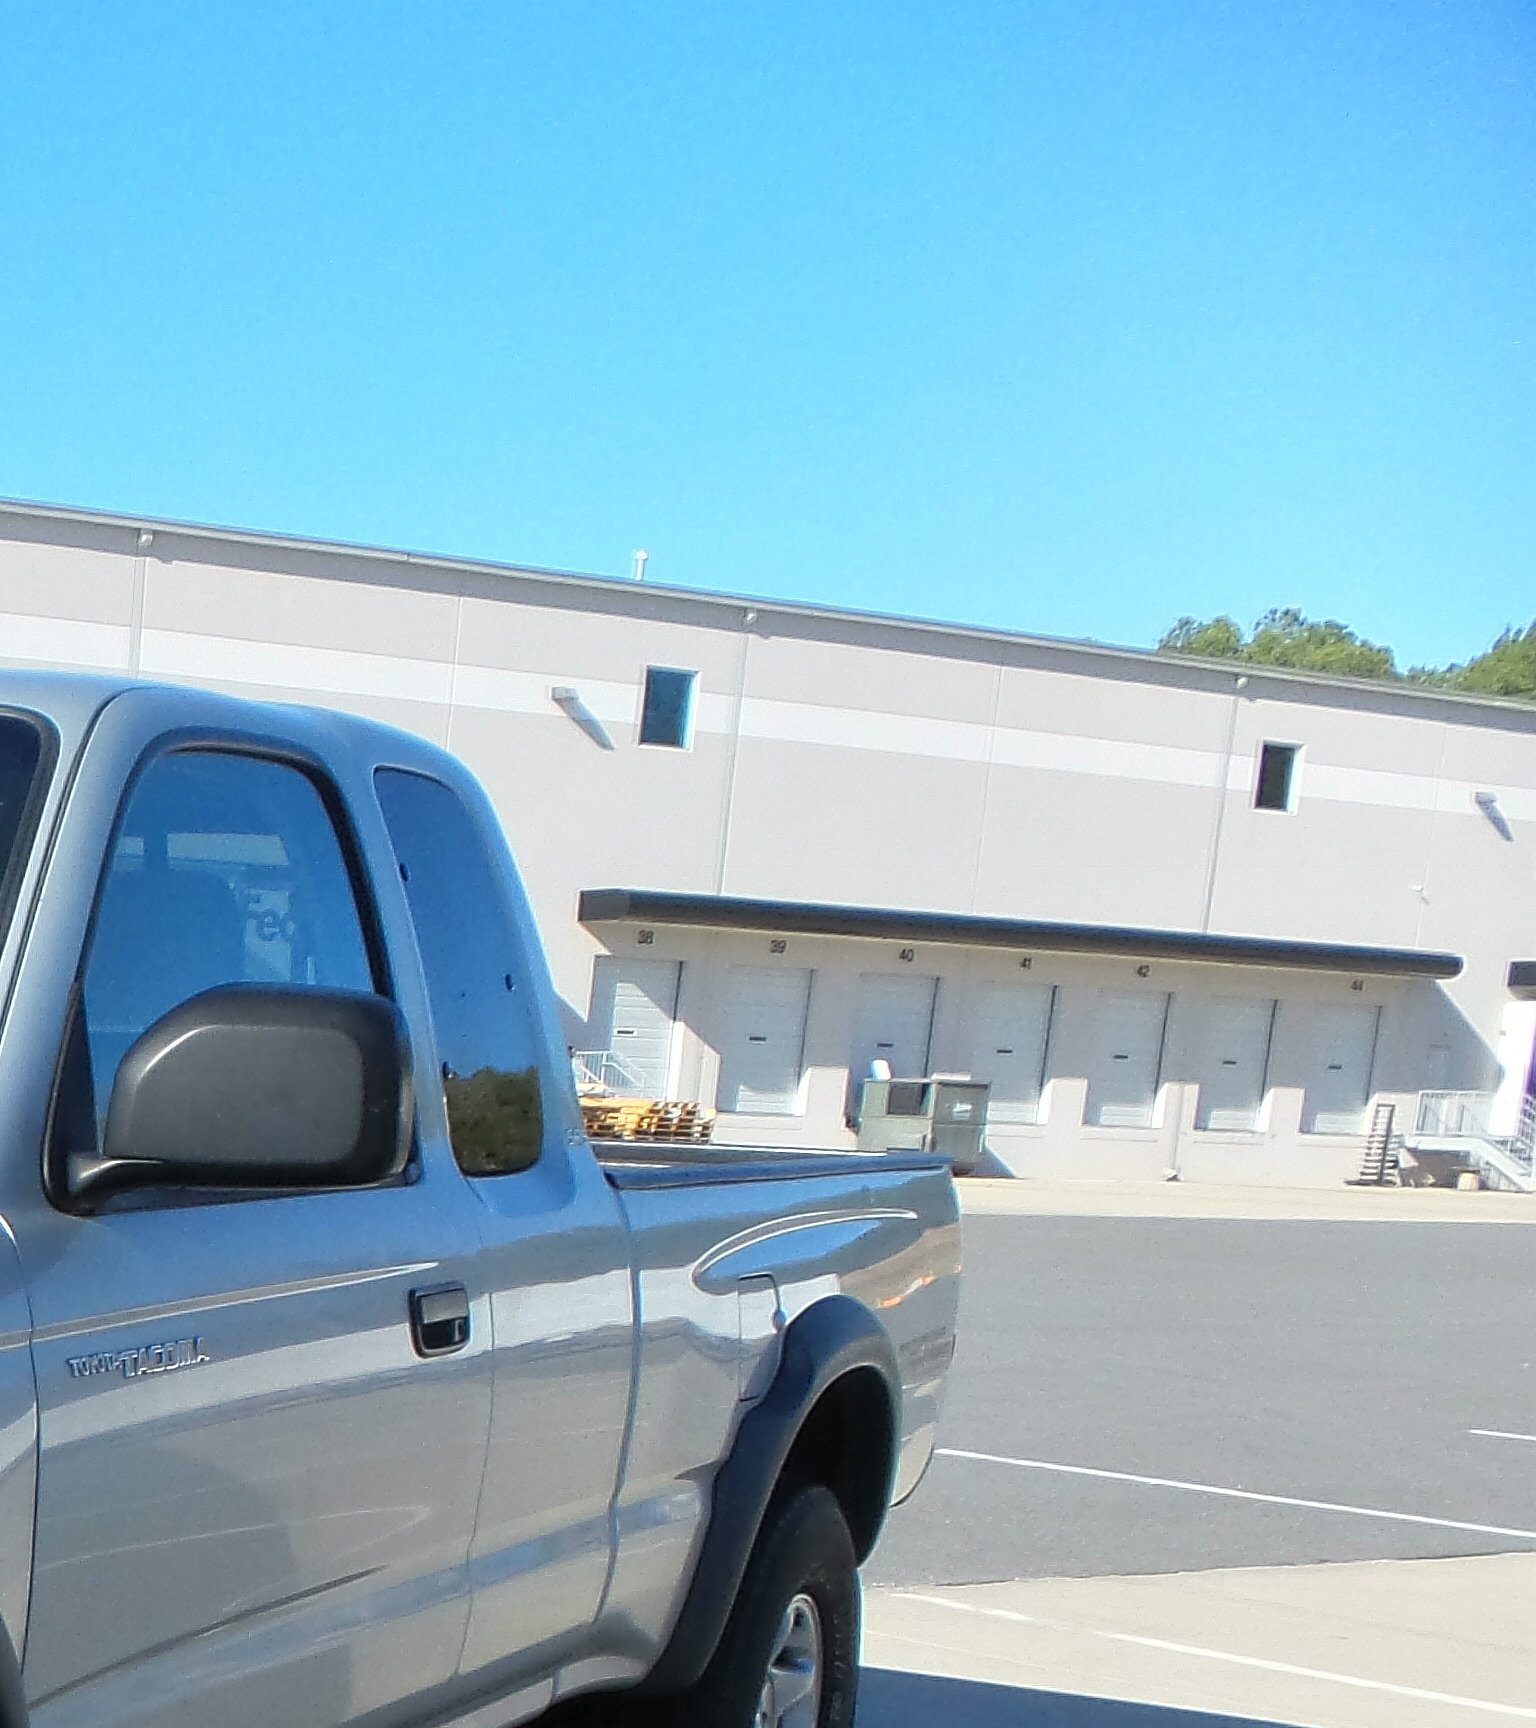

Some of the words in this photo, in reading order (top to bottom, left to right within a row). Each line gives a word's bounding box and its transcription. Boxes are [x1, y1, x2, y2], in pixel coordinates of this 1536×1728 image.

[637, 929, 654, 945] 38
[770, 939, 787, 954] 39
[898, 948, 915, 962] 40
[119, 1336, 211, 1378] TACOMA
